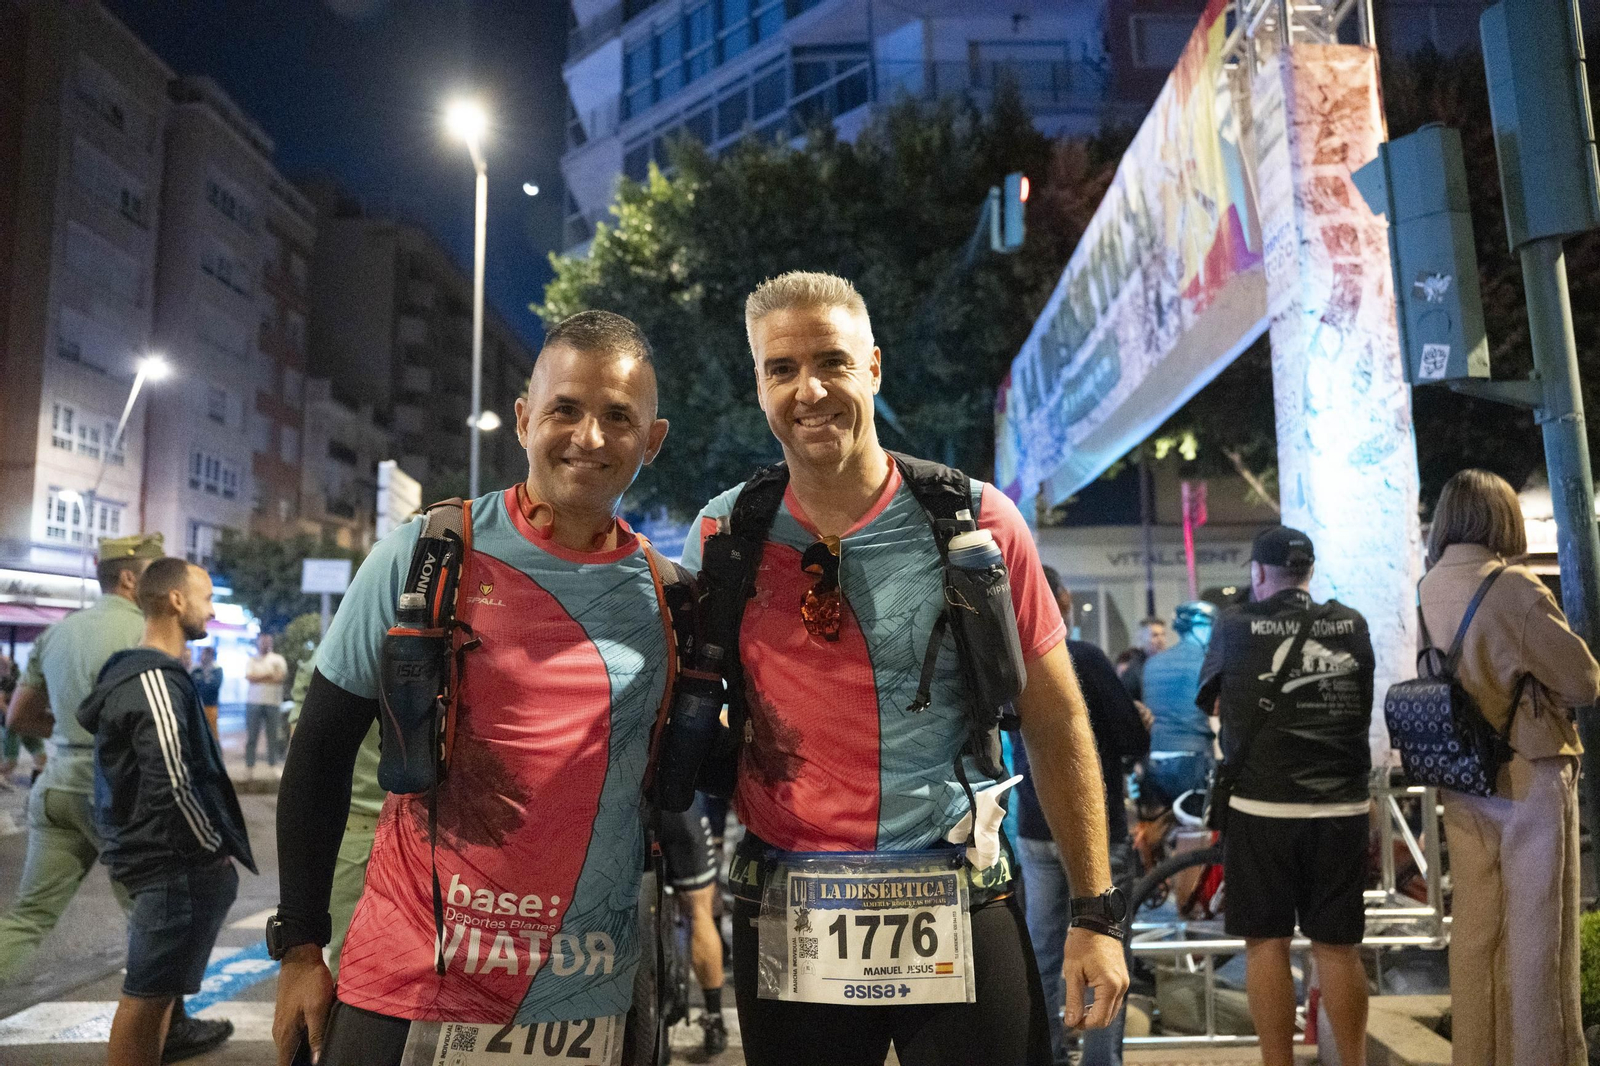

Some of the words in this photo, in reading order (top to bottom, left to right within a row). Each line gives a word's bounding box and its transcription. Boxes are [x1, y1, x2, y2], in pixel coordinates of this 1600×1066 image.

[820, 883, 843, 899] LA
[844, 879, 946, 900] DESÉRTICA
[444, 907, 506, 929] Deportes
[509, 920, 557, 933] Blanes
[434, 924, 616, 977] VIATOR
[828, 911, 938, 960] 1776
[863, 966, 903, 976] MANUEL
[906, 963, 934, 974] JESÚS
[440, 1024, 454, 1059] INDIVIDUAL
